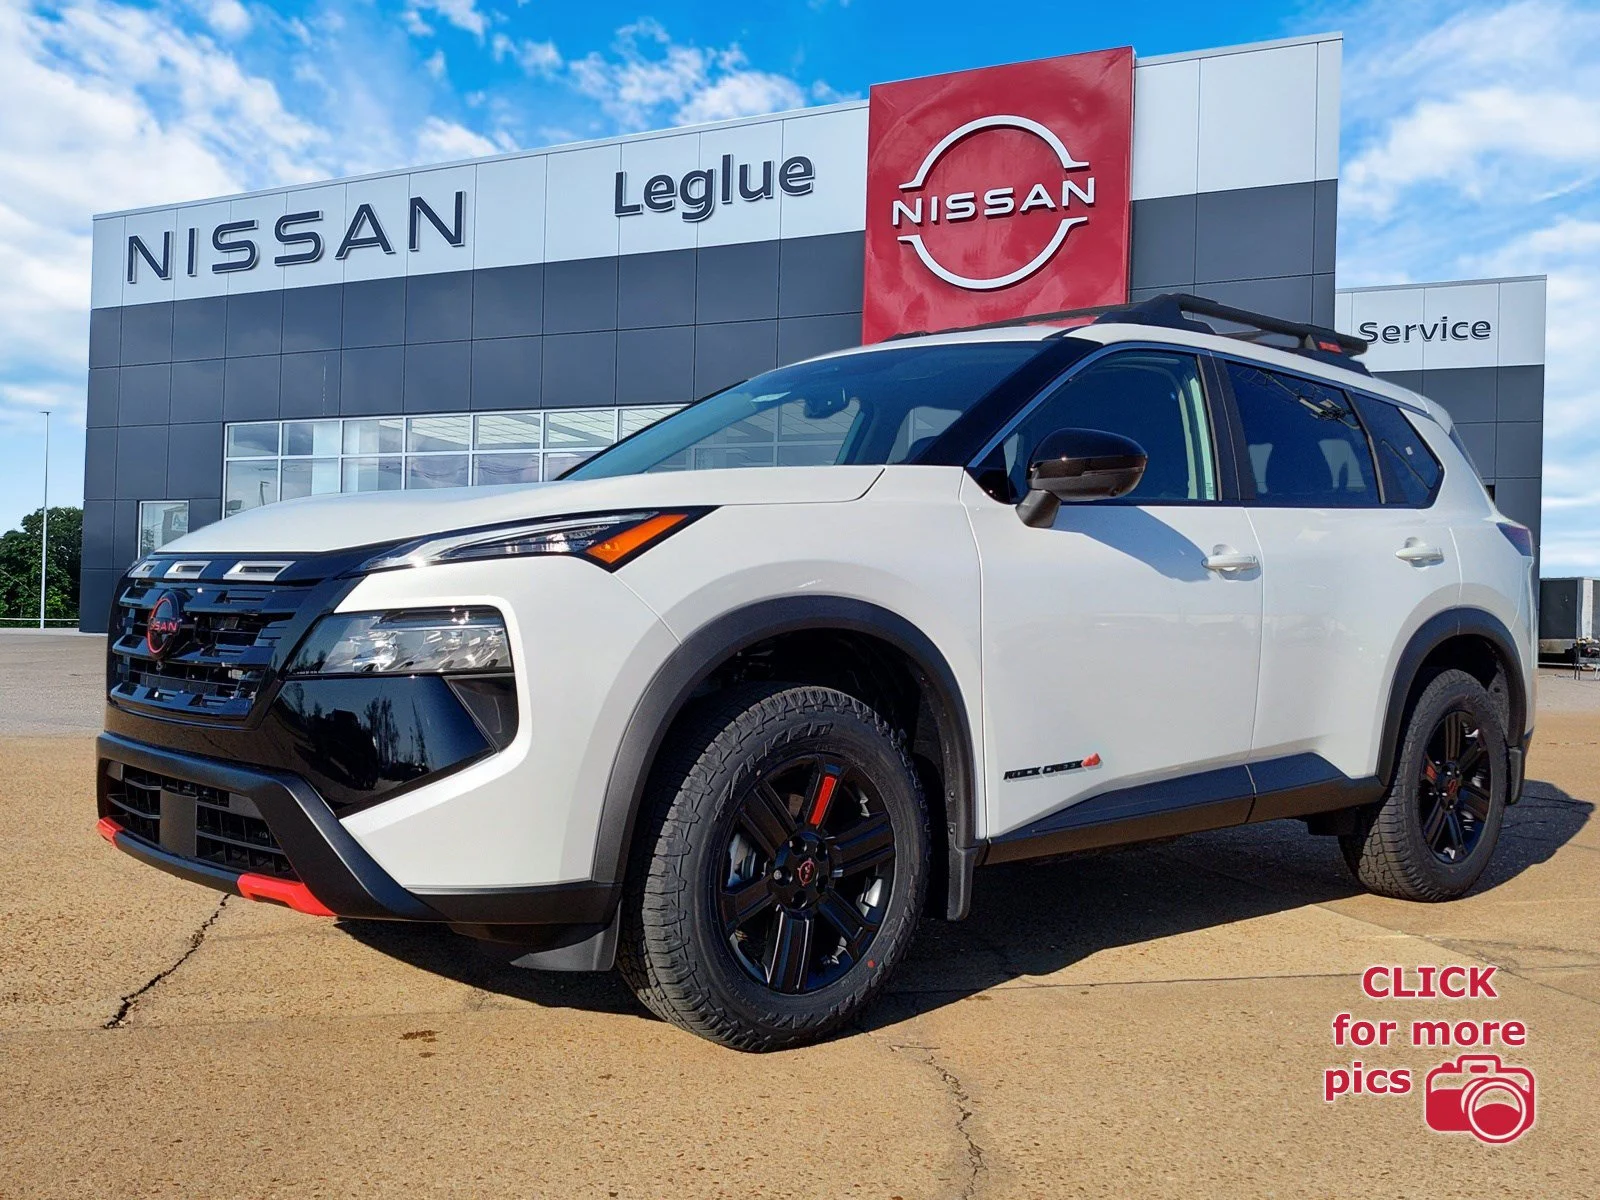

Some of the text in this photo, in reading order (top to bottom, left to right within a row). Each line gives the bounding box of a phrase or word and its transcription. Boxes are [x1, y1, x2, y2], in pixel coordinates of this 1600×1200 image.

[614, 154, 815, 222] Leglue
[892, 176, 1096, 227] NISSAN
[127, 190, 467, 285] NISSAN
[1358, 314, 1493, 346] Service
